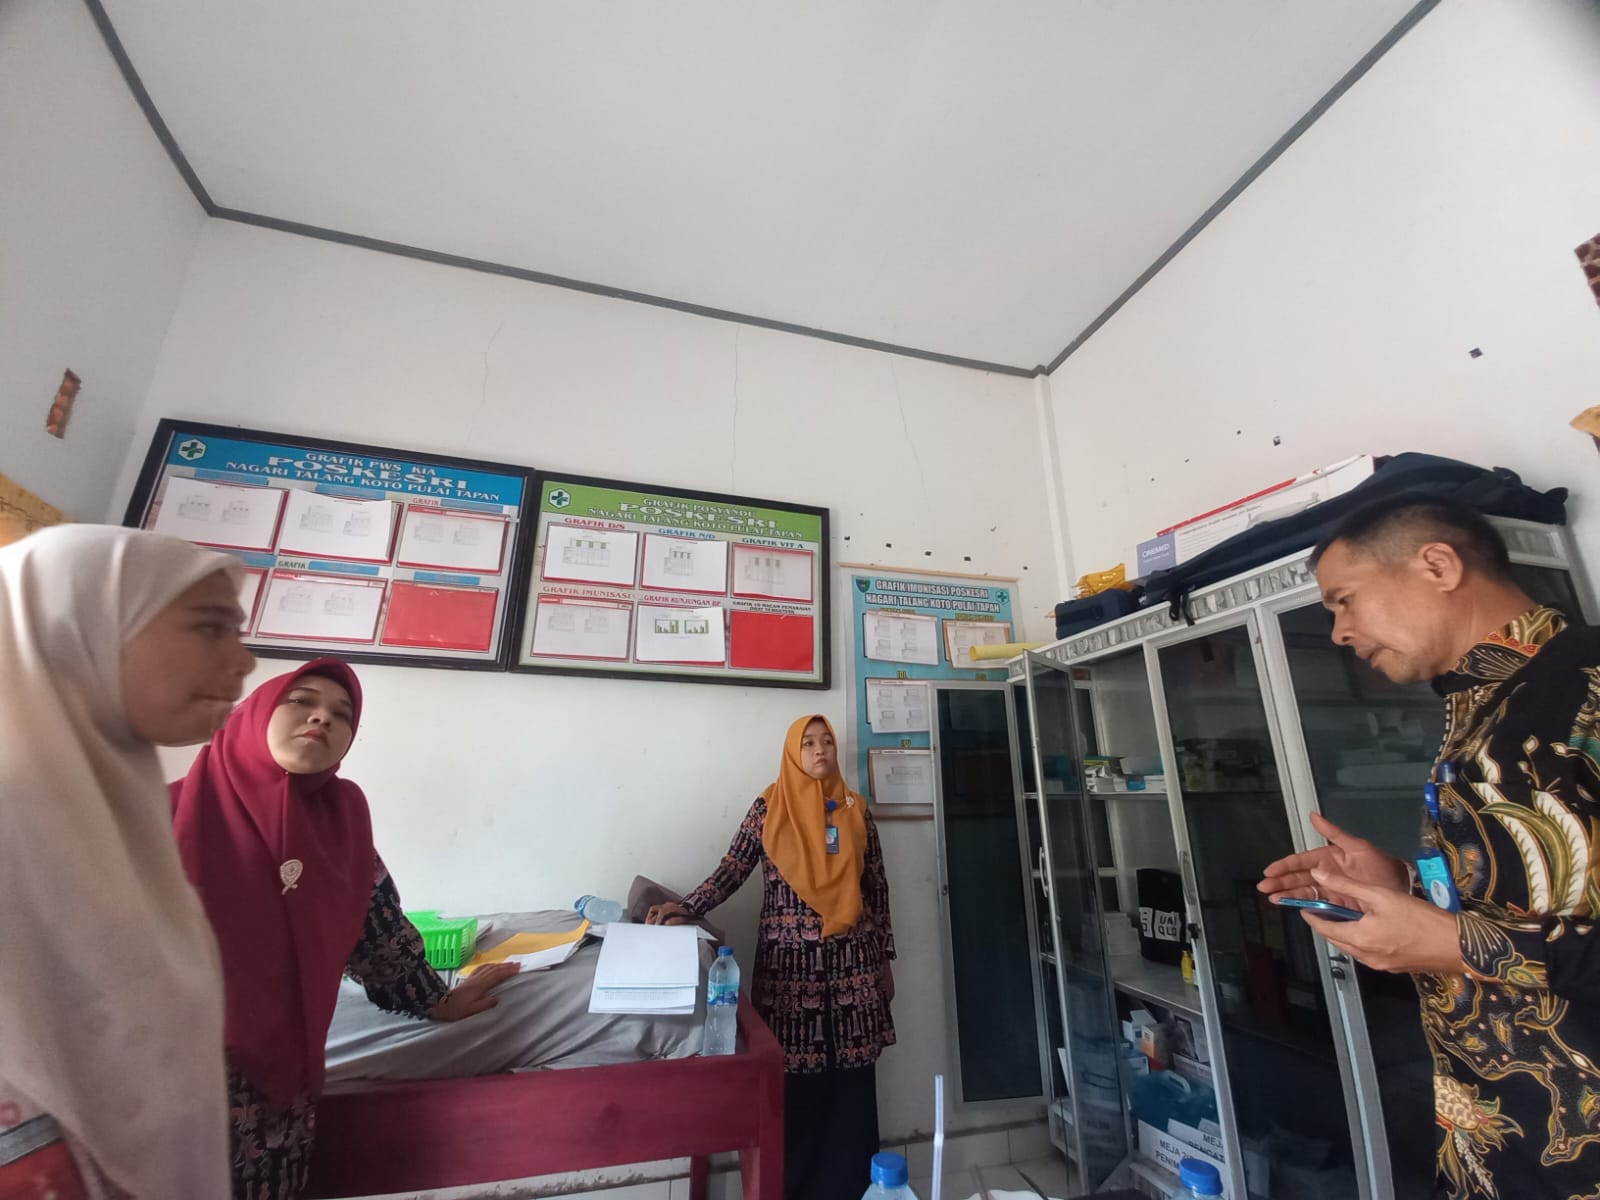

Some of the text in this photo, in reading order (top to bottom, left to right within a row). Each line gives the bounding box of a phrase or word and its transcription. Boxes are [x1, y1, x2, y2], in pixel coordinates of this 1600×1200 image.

[267, 456, 467, 489] POSKESRI
[306, 453, 436, 475] GRAFIK PWS KIA
[226, 461, 500, 501] NAGARI TALANG KOTO PULAI TAPAN
[412, 497, 440, 507] GRAFIK
[643, 498, 756, 517] GRAFIK POSYANDU
[565, 518, 605, 528] GRAFIK
[589, 508, 803, 538] NAGARI TALANG KOTO PULAI TAPAN
[620, 503, 776, 528] POSKESRI
[658, 528, 696, 538] GRAFIK
[742, 537, 777, 547] GRAFIK
[278, 561, 306, 569] GRAFIK
[543, 585, 632, 599] GRAFIK IMUNISASI
[644, 594, 669, 603] GRAFIK
[876, 580, 989, 599] GRAFIK IMUNISASI POSKESRI
[865, 593, 1000, 613] NAGARI TALANG KOTO PULAI TAPAN
[1159, 1139, 1180, 1157] MEJA
